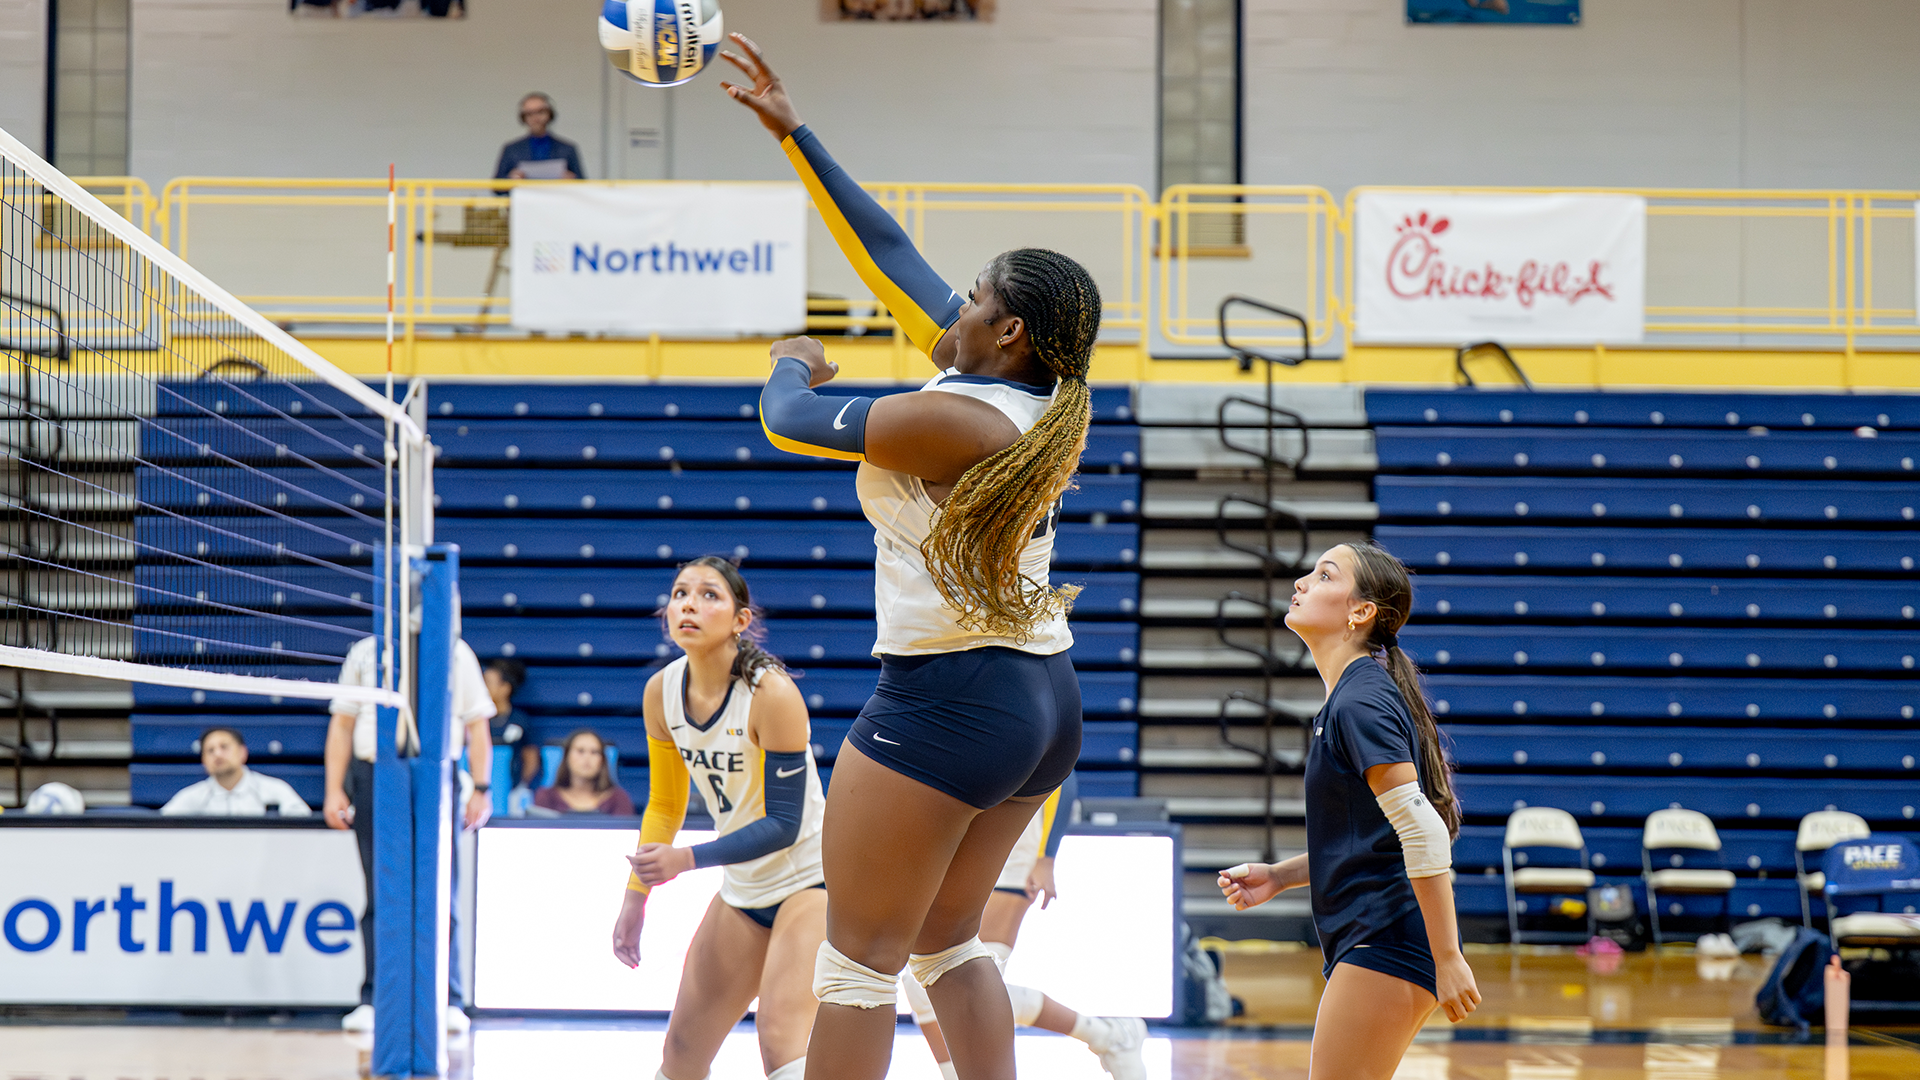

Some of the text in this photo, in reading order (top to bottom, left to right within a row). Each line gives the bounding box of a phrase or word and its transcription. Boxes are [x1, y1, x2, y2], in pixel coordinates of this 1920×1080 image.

[681, 2, 701, 69] molten
[571, 241, 774, 274] Northwell
[1385, 230, 1615, 309] Chick-fil-A
[679, 746, 744, 773] PACE
[707, 773, 733, 814] 6
[1843, 844, 1903, 866] PACE
[2, 879, 357, 954] orthwe
